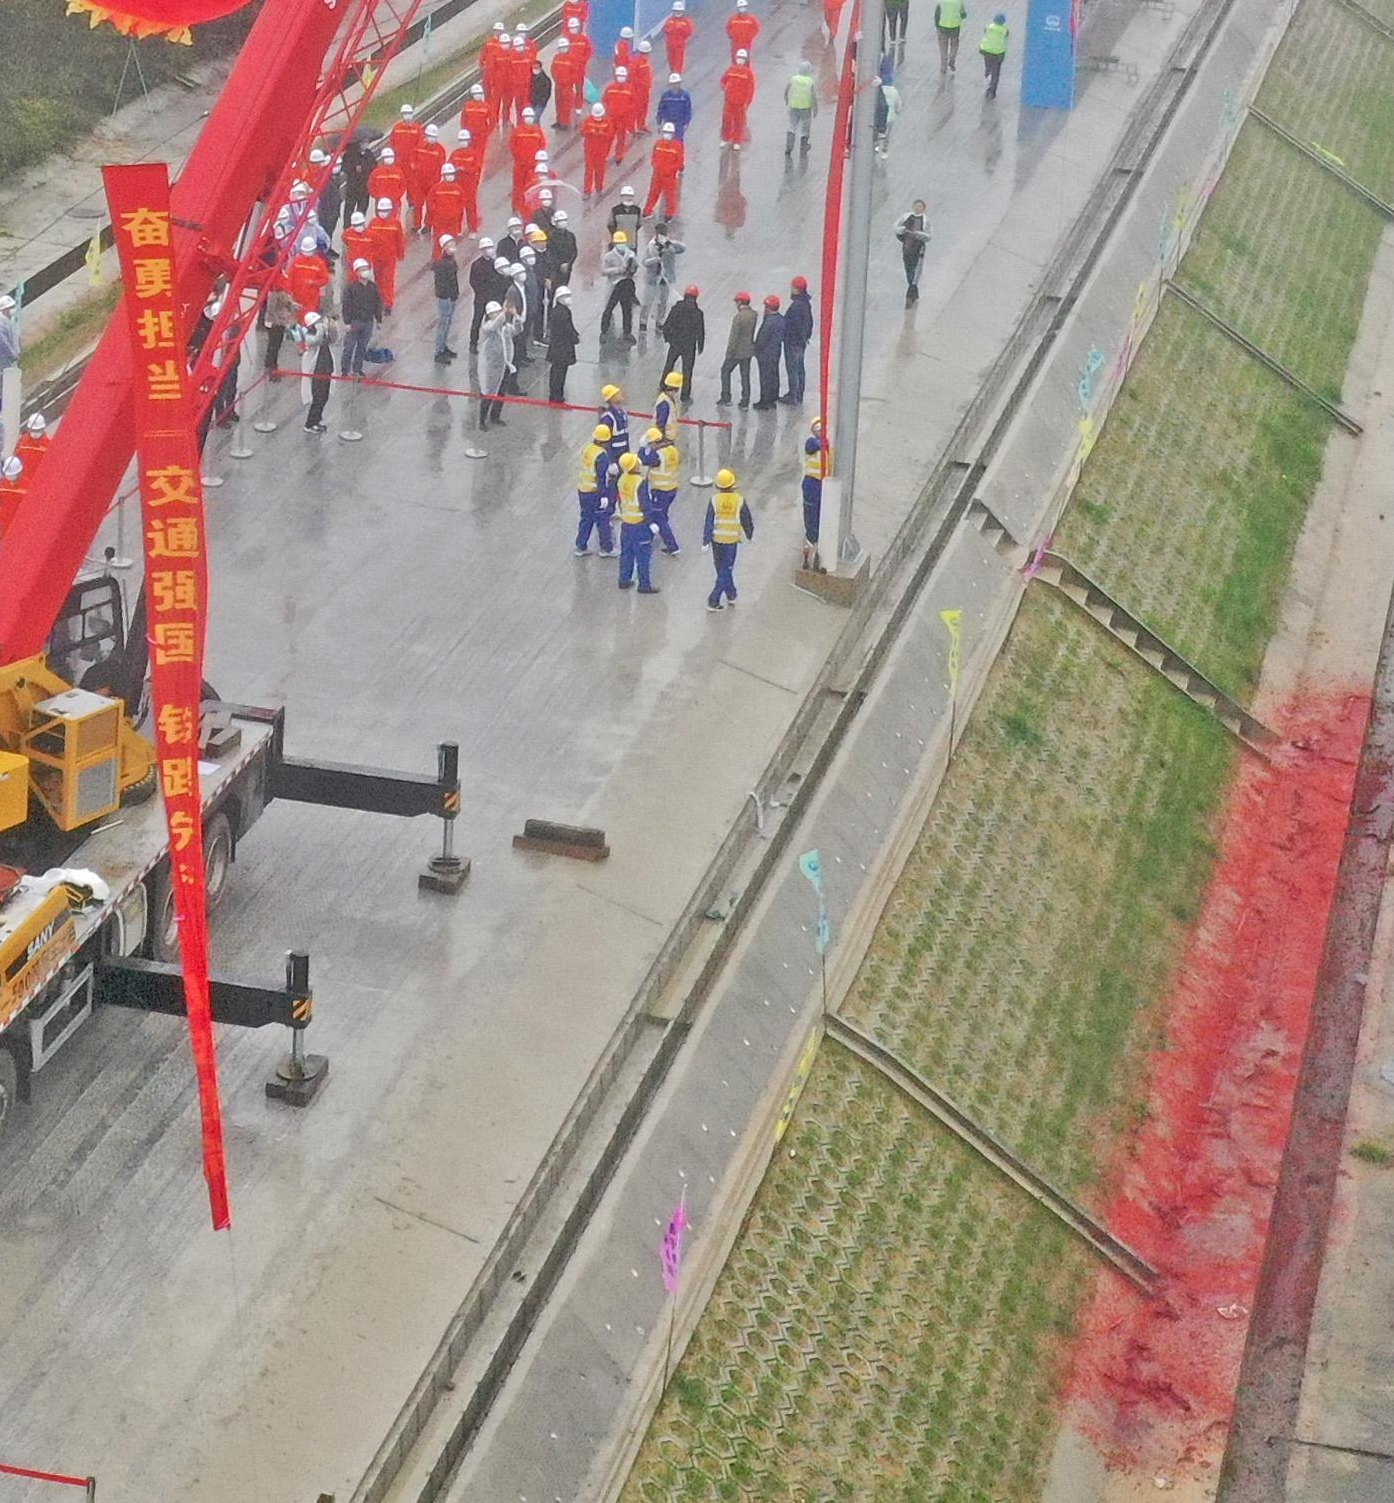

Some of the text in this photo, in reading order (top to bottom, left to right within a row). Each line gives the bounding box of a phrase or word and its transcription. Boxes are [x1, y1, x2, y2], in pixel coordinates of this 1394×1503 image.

[120, 208, 182, 400] 奋勇担当
[145, 465, 200, 665] 交通强国
[26, 920, 56, 961] SANY
